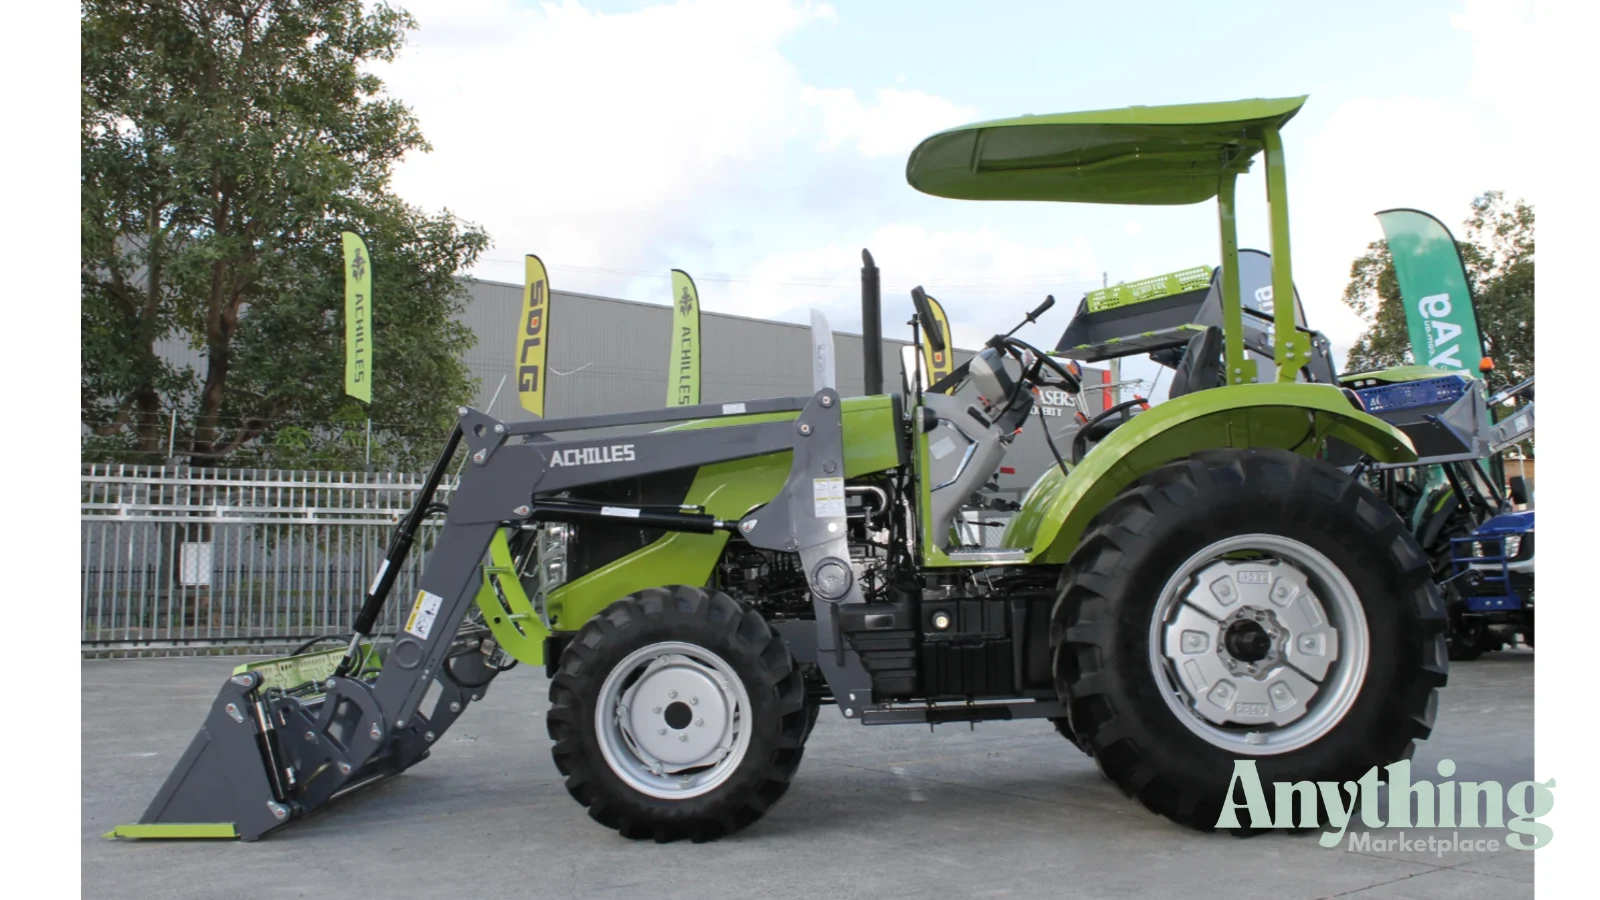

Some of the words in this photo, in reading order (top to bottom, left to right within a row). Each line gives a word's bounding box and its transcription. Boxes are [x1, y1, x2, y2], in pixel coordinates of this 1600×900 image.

[354, 293, 365, 384] ACHILLES
[518, 279, 544, 392] SDLG
[678, 326, 692, 405] ACHILLES
[1035, 390, 1075, 407] ASERS
[550, 444, 636, 468] ACHILLES
